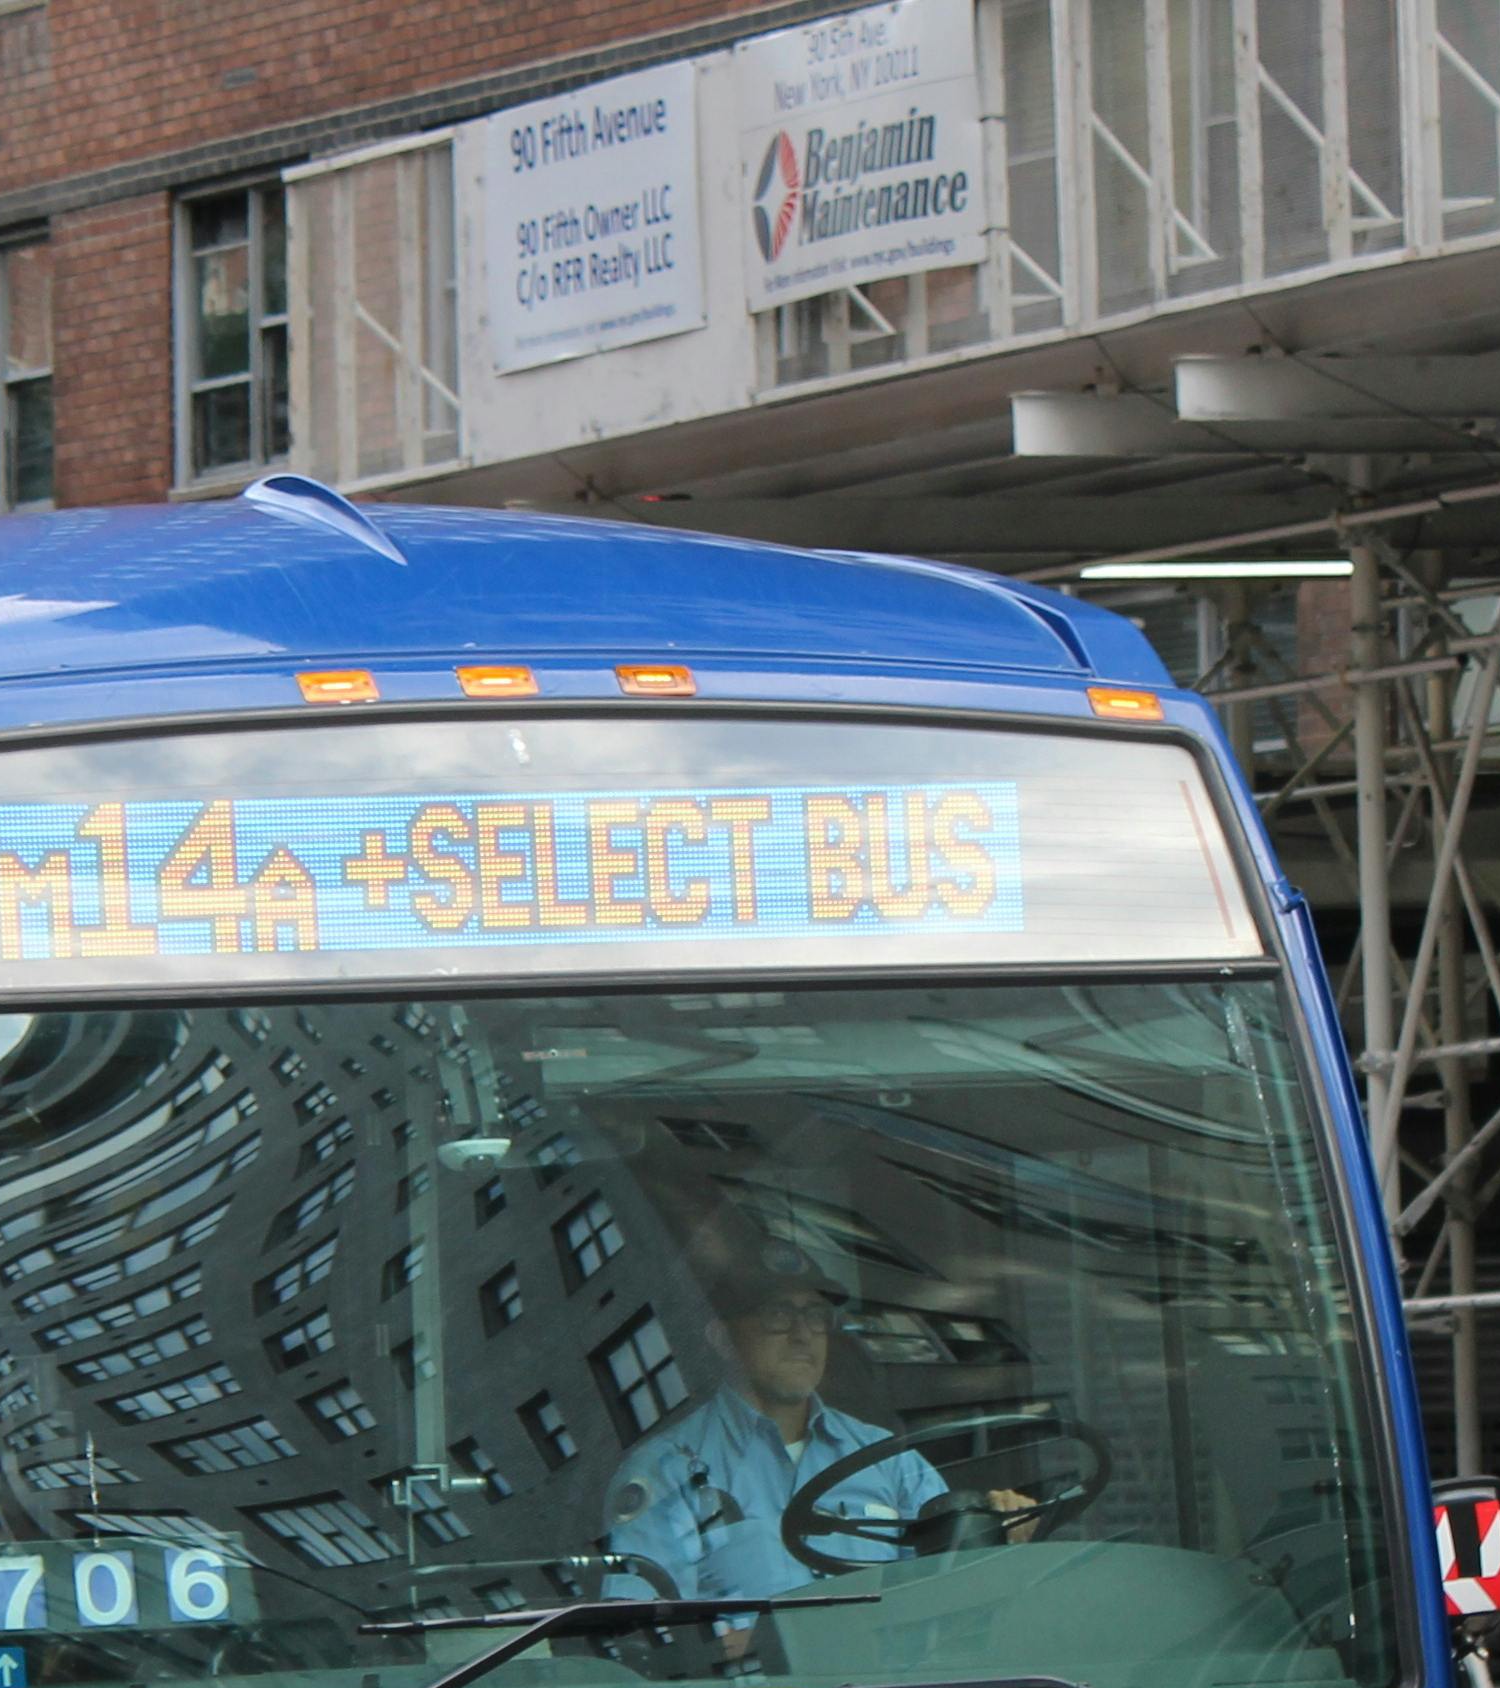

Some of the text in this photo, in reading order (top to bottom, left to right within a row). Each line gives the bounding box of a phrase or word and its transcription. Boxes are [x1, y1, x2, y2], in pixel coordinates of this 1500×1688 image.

[510, 98, 667, 174] 90 Fifth Avenue
[802, 107, 937, 189] Benjamin
[517, 183, 673, 260] 90 Fifth Owner LLC
[799, 169, 968, 246] Maintenance
[516, 260, 549, 312] C/o
[590, 242, 641, 290] Realty
[644, 231, 675, 275] LLC
[344, 796, 772, 932] +SELECT
[804, 789, 995, 922] BUS
